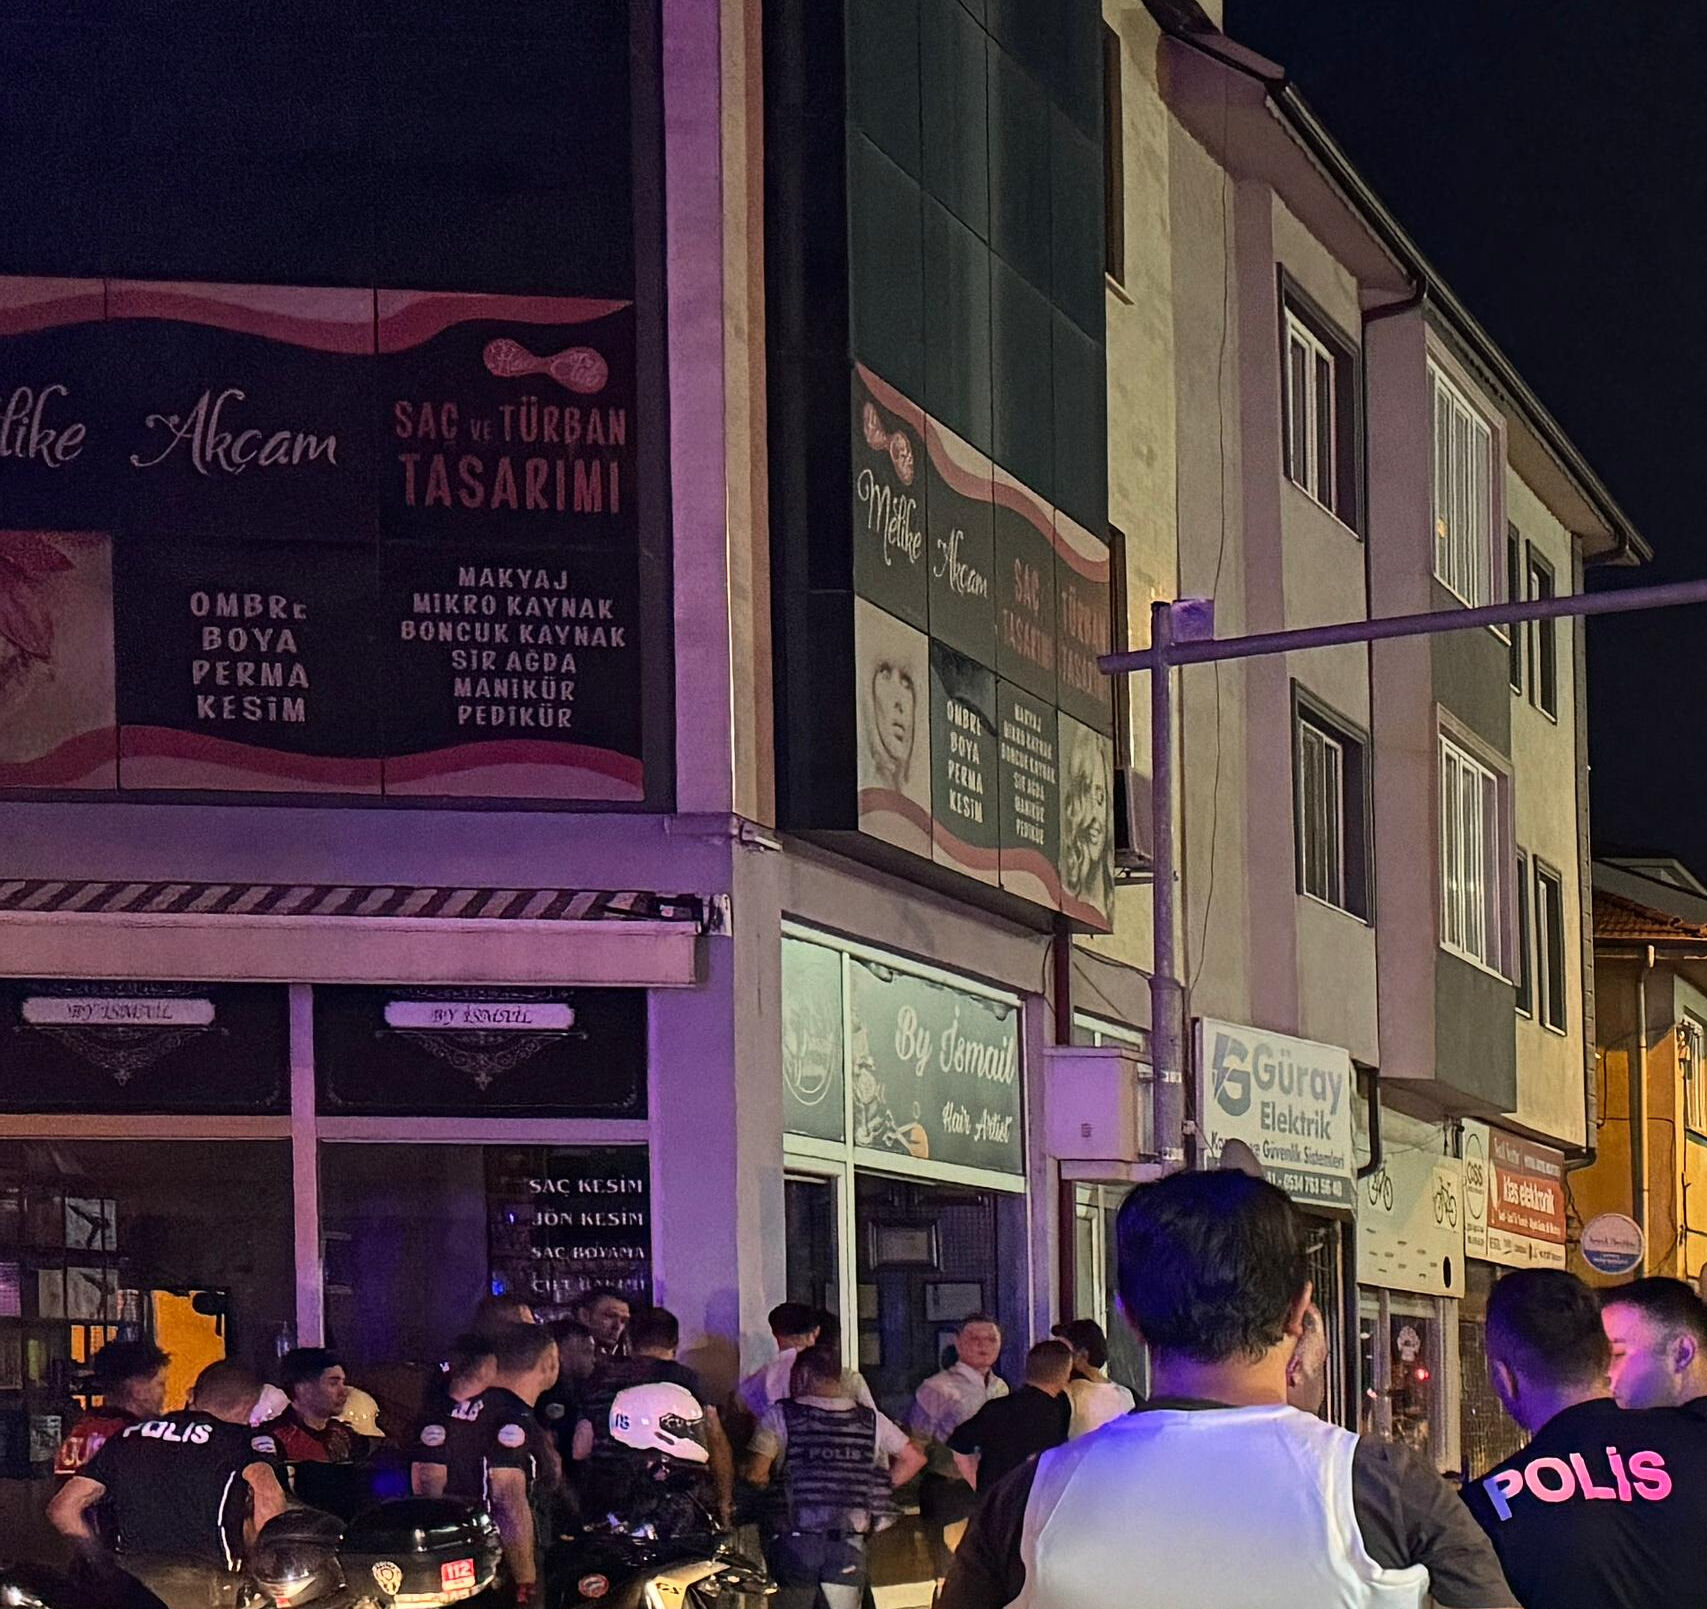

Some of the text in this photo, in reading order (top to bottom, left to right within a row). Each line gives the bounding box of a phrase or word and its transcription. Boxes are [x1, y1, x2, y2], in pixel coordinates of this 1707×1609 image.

[129, 387, 338, 476] Akçam
[394, 400, 458, 447] SAÇ
[499, 396, 627, 446] TÜRBAN
[398, 453, 620, 514] TASARIMI
[857, 469, 921, 566] Melike
[458, 567, 568, 590] MAKYAJ
[507, 595, 614, 620] KAYNAK
[202, 626, 298, 653] BOYA
[401, 620, 626, 648] BONCUK KAYNAK
[192, 659, 310, 688] PERMA
[506, 648, 577, 674] AĞDA
[197, 694, 306, 722] KESİM
[458, 703, 573, 728] PEDİKÜR
[950, 732, 980, 765] BOYA
[948, 759, 984, 795] PERMA
[949, 789, 984, 823] KESİM
[895, 1005, 933, 1077] By
[1252, 1043, 1343, 1116] Güray
[1260, 1101, 1332, 1141] Elektrik
[1262, 1139, 1300, 1164] Güvenlik
[1303, 1146, 1345, 1170] Sistemleri
[529, 1174, 643, 1198] SAÇ KESİM
[581, 1207, 644, 1226] KESİM
[1483, 1446, 1673, 1522] POLİS
